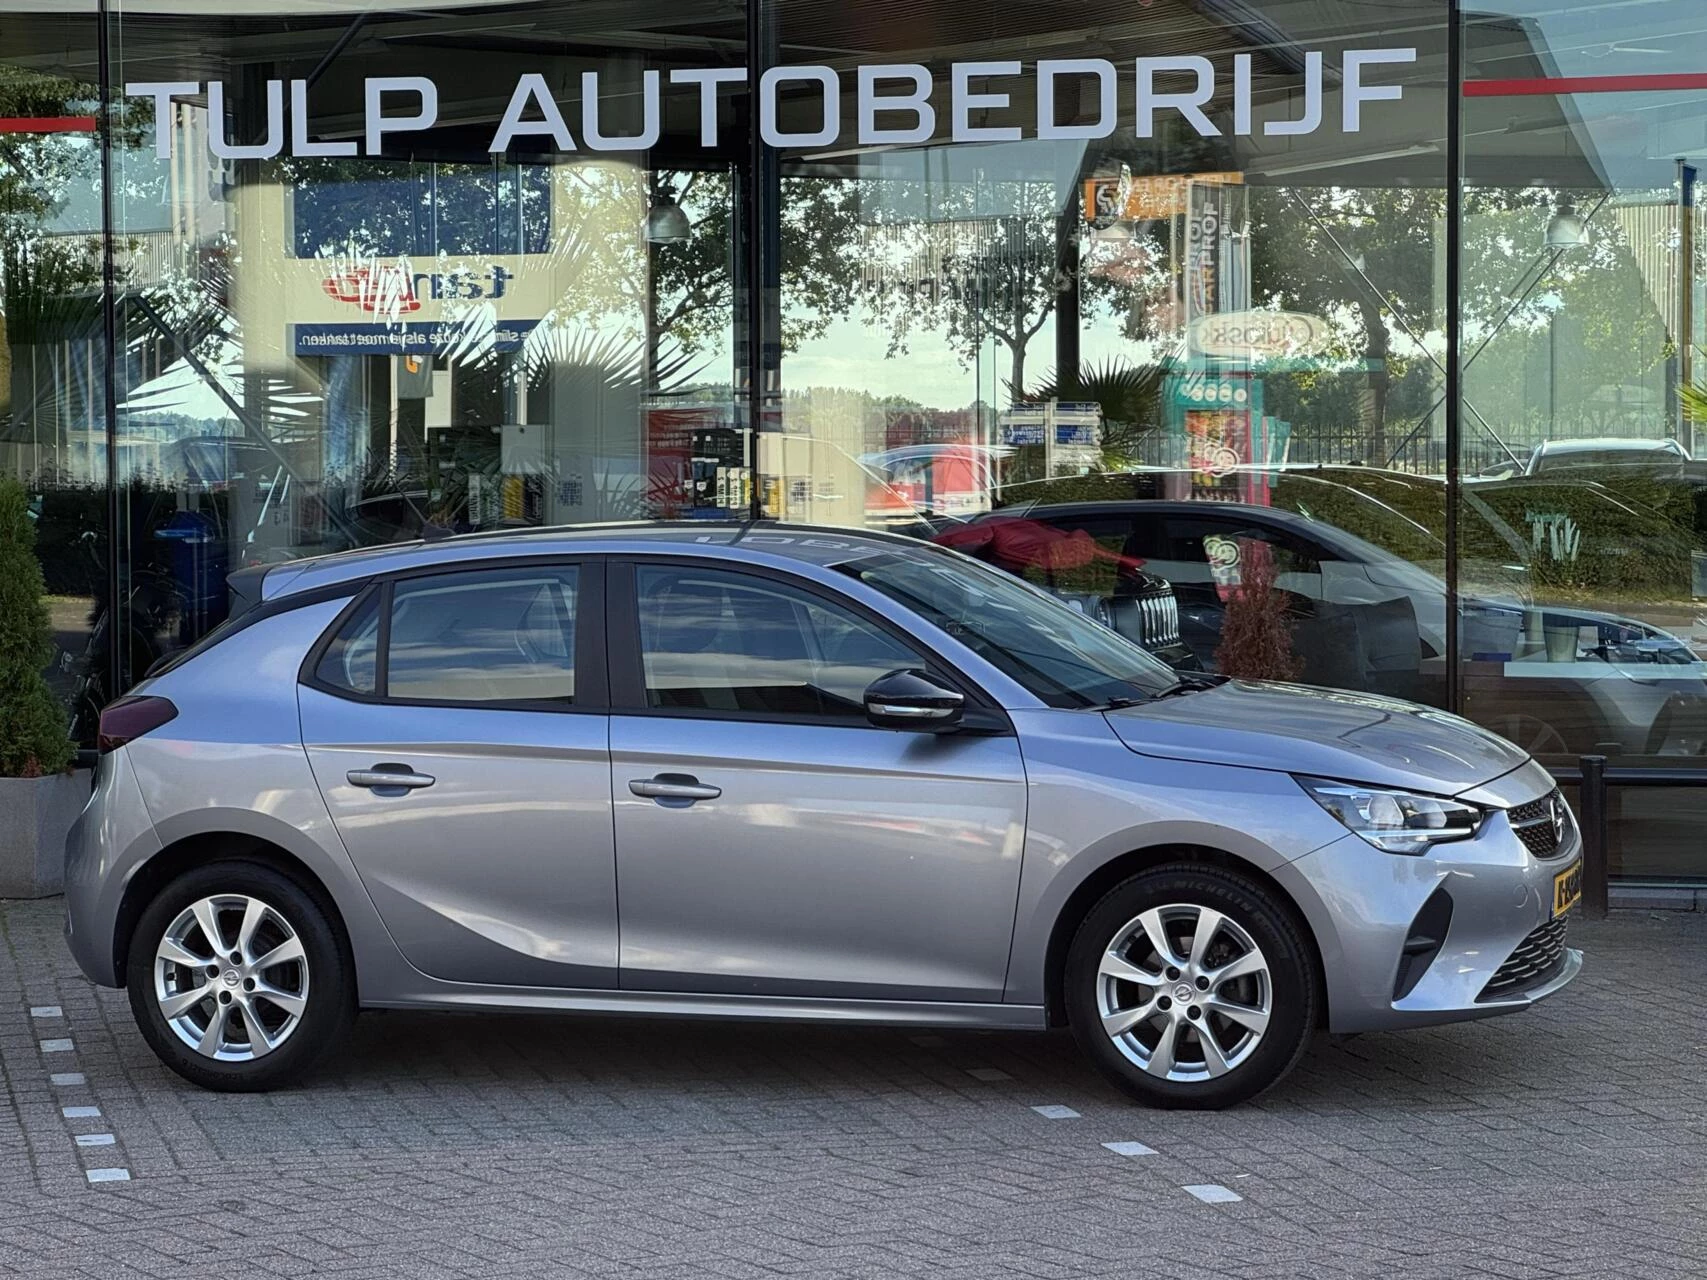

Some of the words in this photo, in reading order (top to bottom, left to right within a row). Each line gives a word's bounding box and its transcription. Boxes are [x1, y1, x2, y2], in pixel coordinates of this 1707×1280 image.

[126, 77, 438, 159] TULP
[488, 47, 1418, 153] AUTOBEDRIJF
[1173, 880, 1254, 912] MICHELIN
